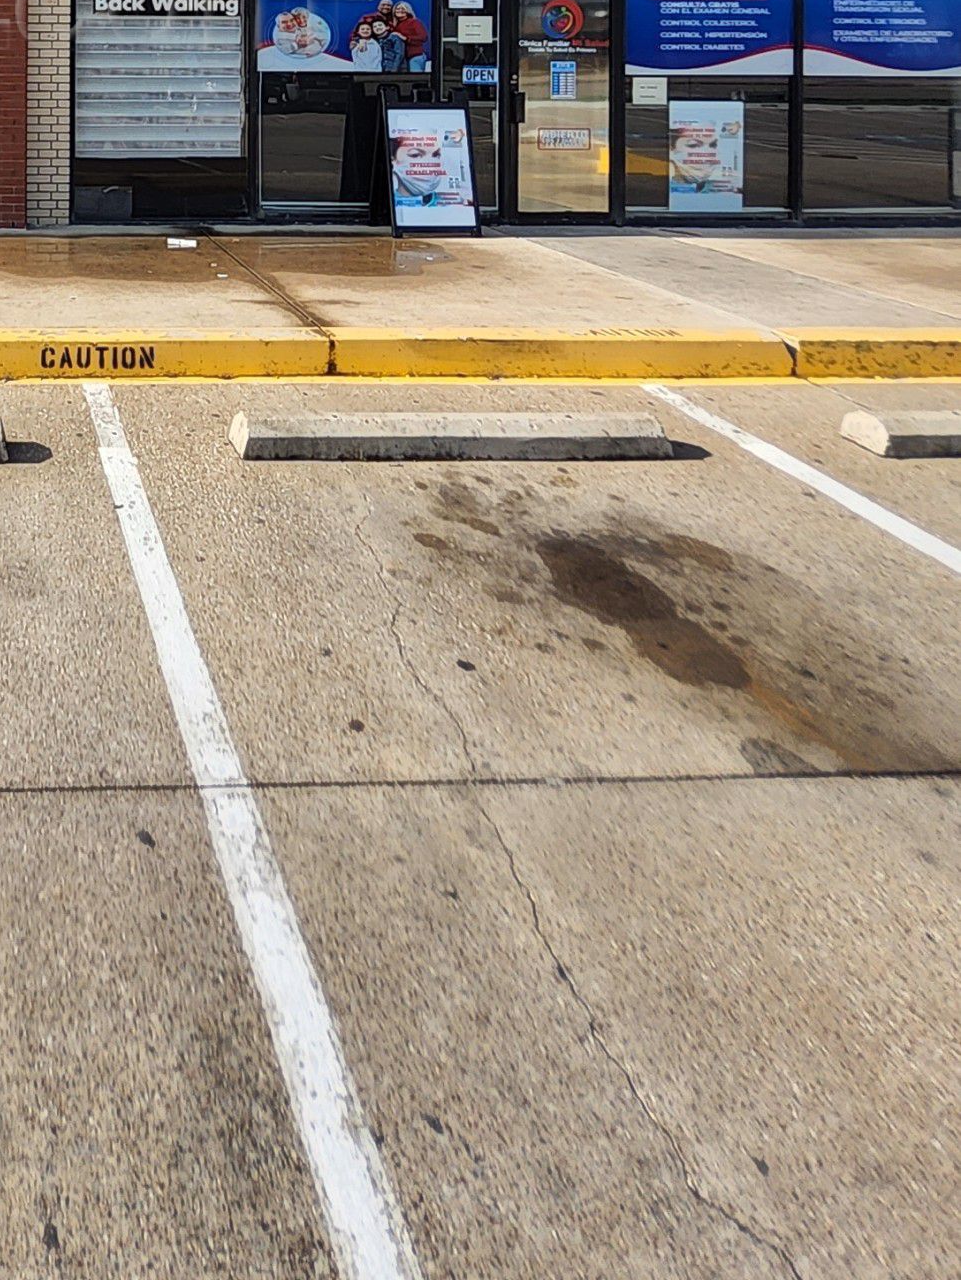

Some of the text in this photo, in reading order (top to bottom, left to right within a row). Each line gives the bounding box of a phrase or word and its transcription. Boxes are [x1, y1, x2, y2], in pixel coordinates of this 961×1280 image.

[465, 69, 495, 81] OPEN
[572, 328, 684, 337] AUTION
[41, 346, 155, 369] CAUTION
